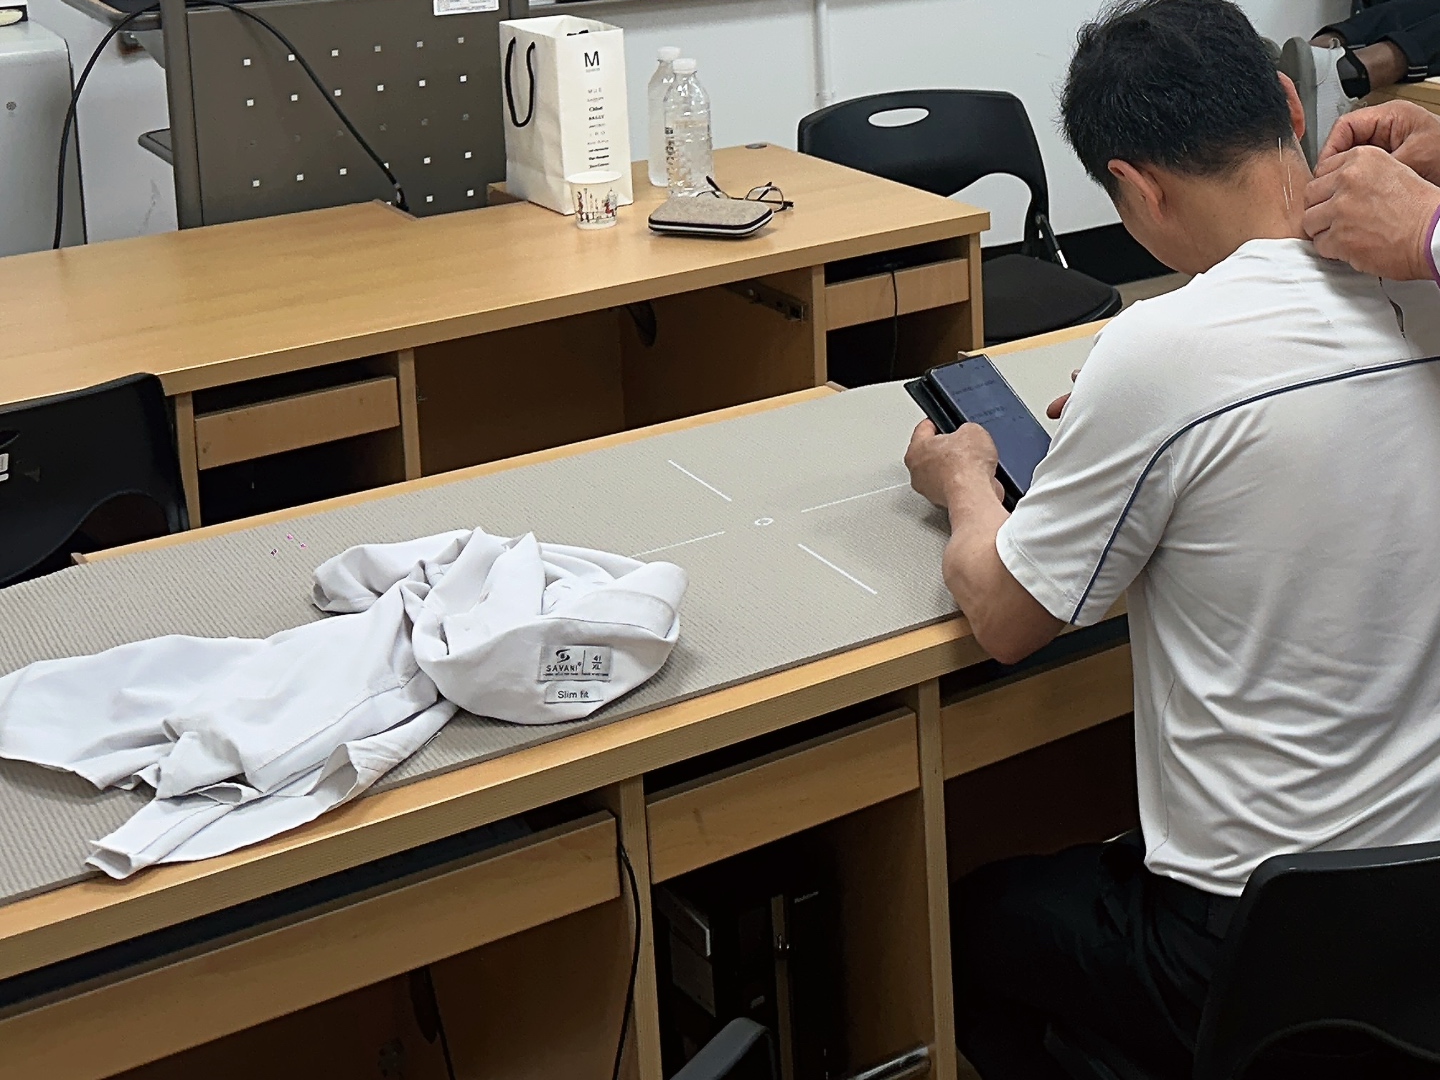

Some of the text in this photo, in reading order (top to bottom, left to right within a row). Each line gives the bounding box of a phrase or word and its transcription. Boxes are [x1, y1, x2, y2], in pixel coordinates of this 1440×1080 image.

[584, 50, 600, 68] M
[557, 690, 589, 699] Slim fit
